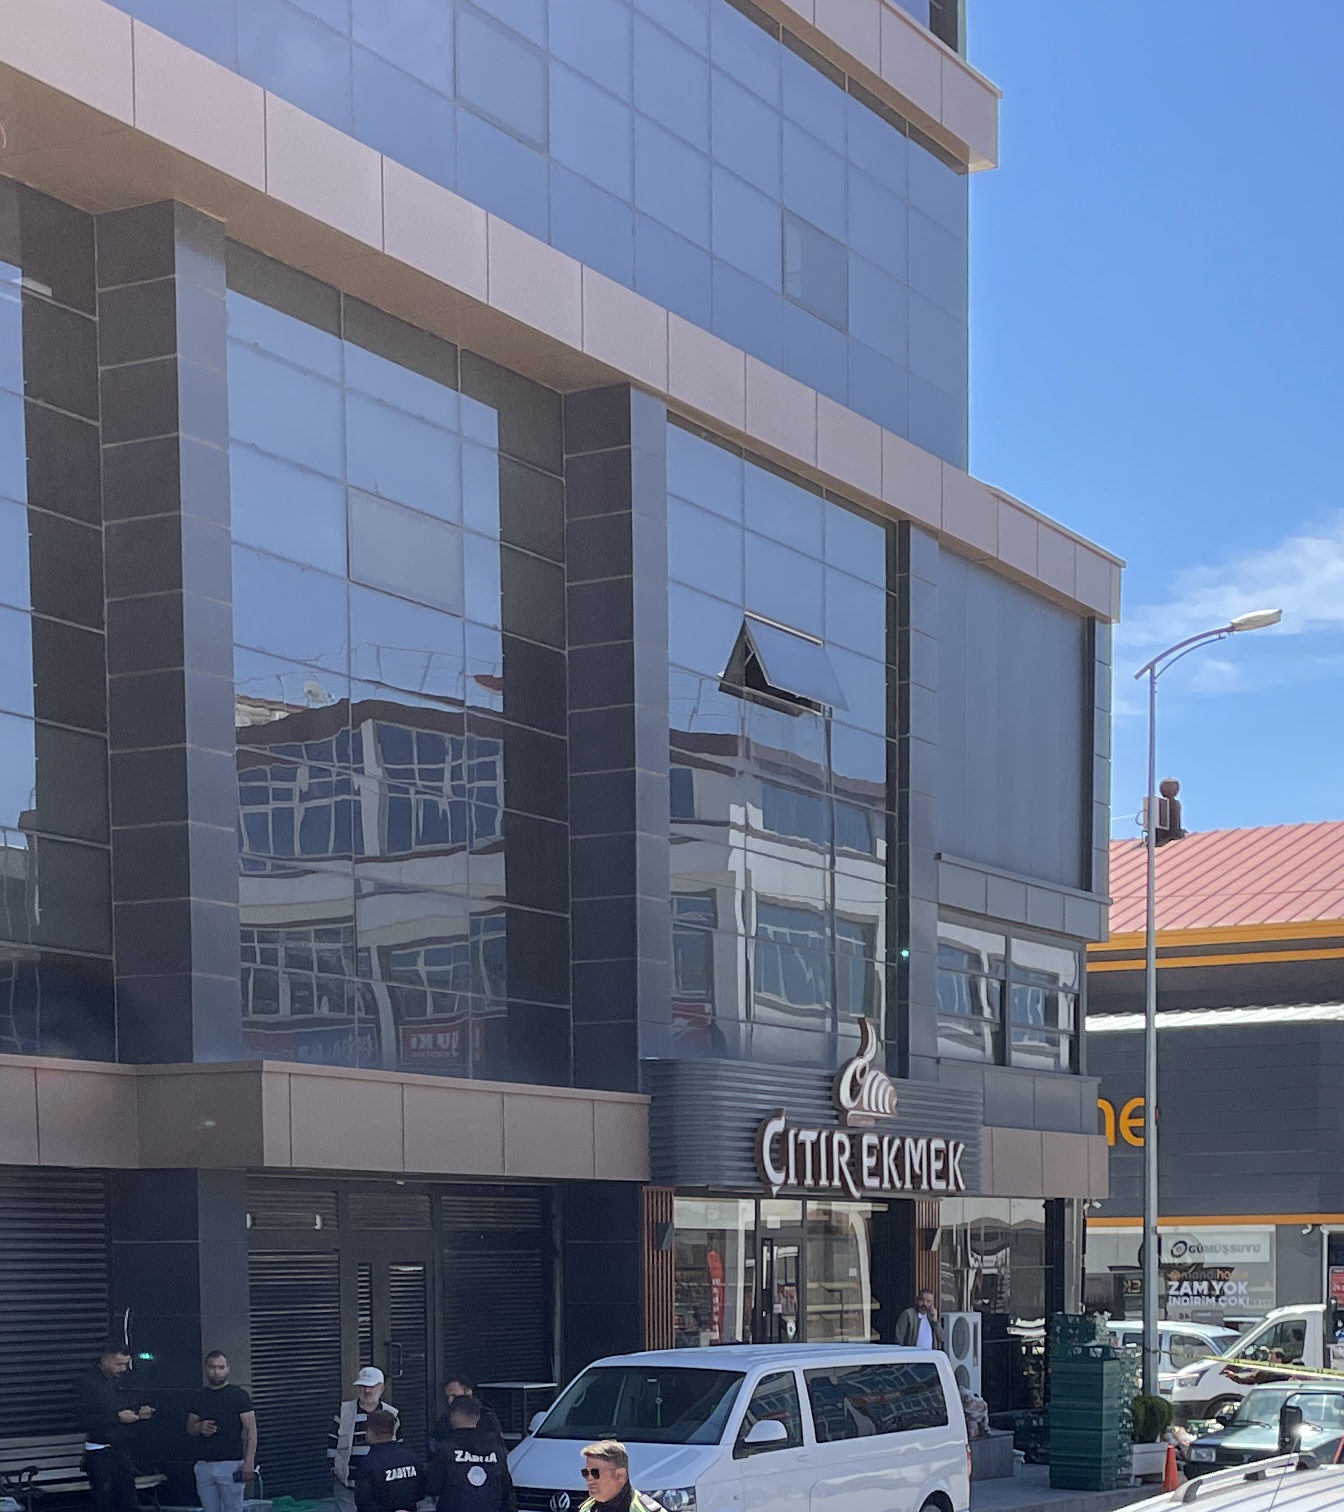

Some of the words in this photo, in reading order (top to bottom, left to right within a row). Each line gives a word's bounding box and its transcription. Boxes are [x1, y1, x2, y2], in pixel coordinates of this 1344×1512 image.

[761, 1110, 861, 1200] ÇITIR
[862, 1132, 966, 1191] EKMEK
[1168, 1281, 1209, 1296] ZAM
[1211, 1281, 1249, 1296] YOK
